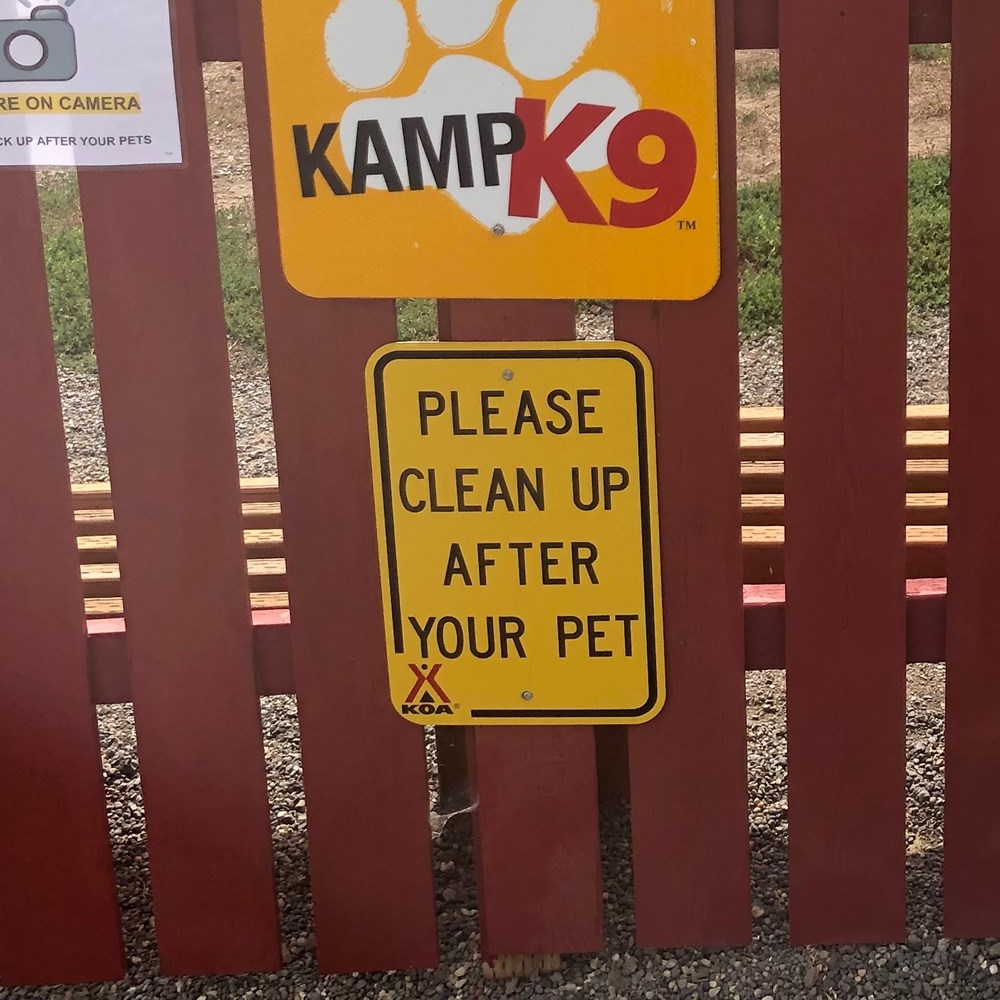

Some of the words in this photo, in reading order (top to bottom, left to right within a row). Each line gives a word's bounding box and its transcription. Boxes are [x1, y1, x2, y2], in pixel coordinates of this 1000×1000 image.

[26, 96, 53, 110] ON
[59, 96, 141, 110] CAMERA
[16, 136, 33, 146] UP
[37, 136, 77, 146] AFTER
[80, 136, 115, 146] YOUR
[119, 135, 152, 145] PETS
[418, 389, 603, 435] PLEASE
[399, 468, 545, 513] CLEAN
[572, 467, 629, 511] UP
[443, 542, 599, 586] AFTER
[409, 616, 526, 659] YOUR
[557, 614, 639, 658] PET
[402, 704, 454, 714] KOA
